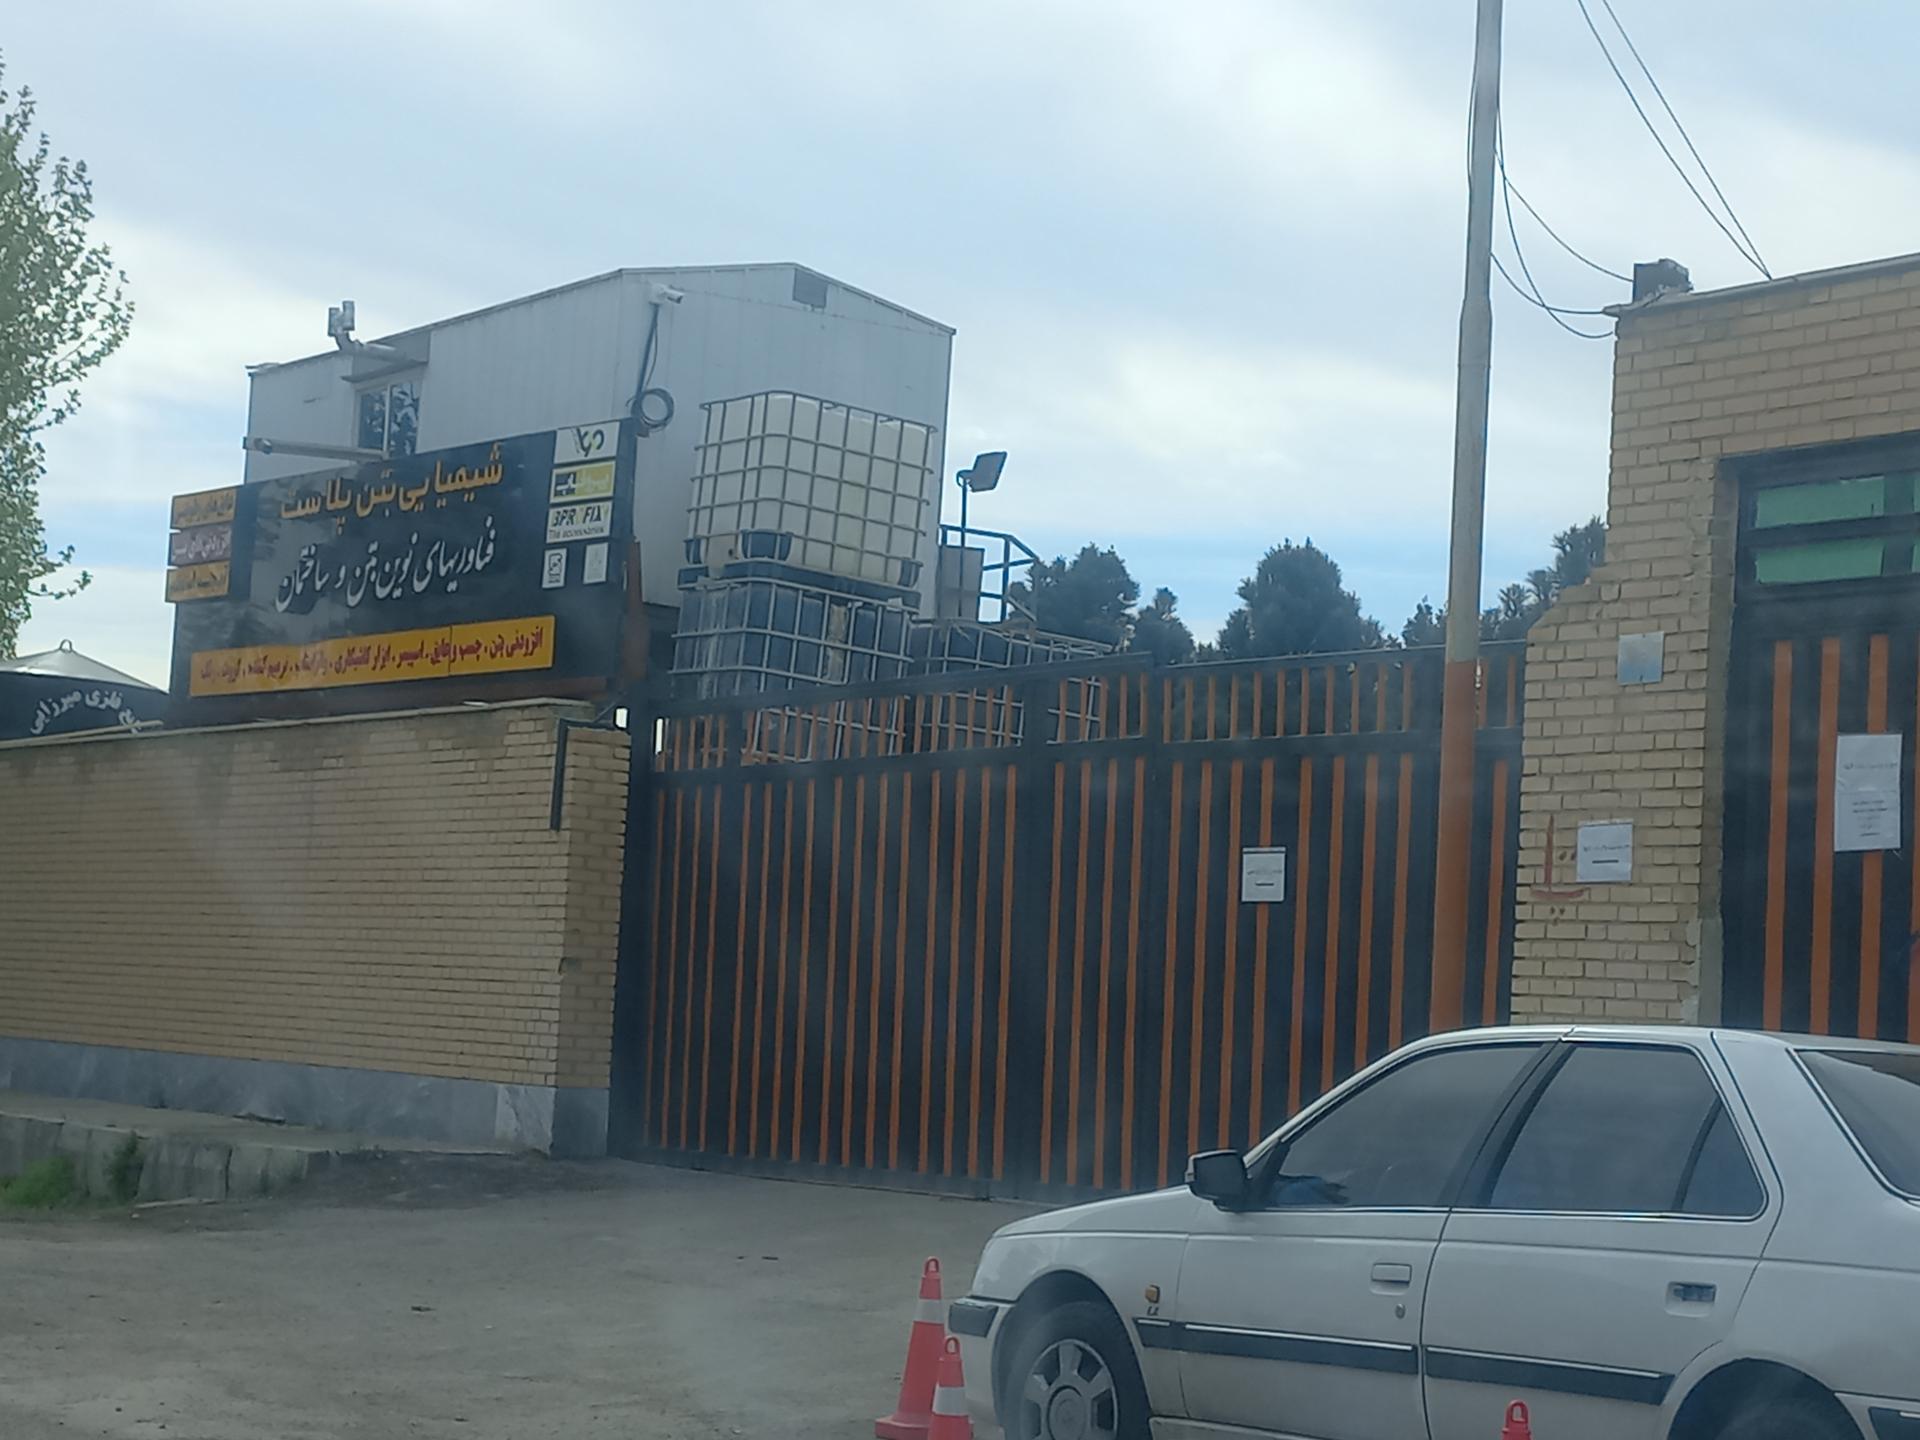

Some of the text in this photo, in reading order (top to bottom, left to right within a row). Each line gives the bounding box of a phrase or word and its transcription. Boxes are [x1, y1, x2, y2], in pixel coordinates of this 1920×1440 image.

[280, 477, 351, 535] پلاست
[356, 468, 396, 518] بتن
[399, 441, 504, 512] شیمیایی
[275, 543, 330, 612] ساختمان
[334, 565, 346, 588] و
[346, 540, 379, 607] بتن
[375, 532, 418, 599] نوین
[85, 690, 123, 709] فلزی
